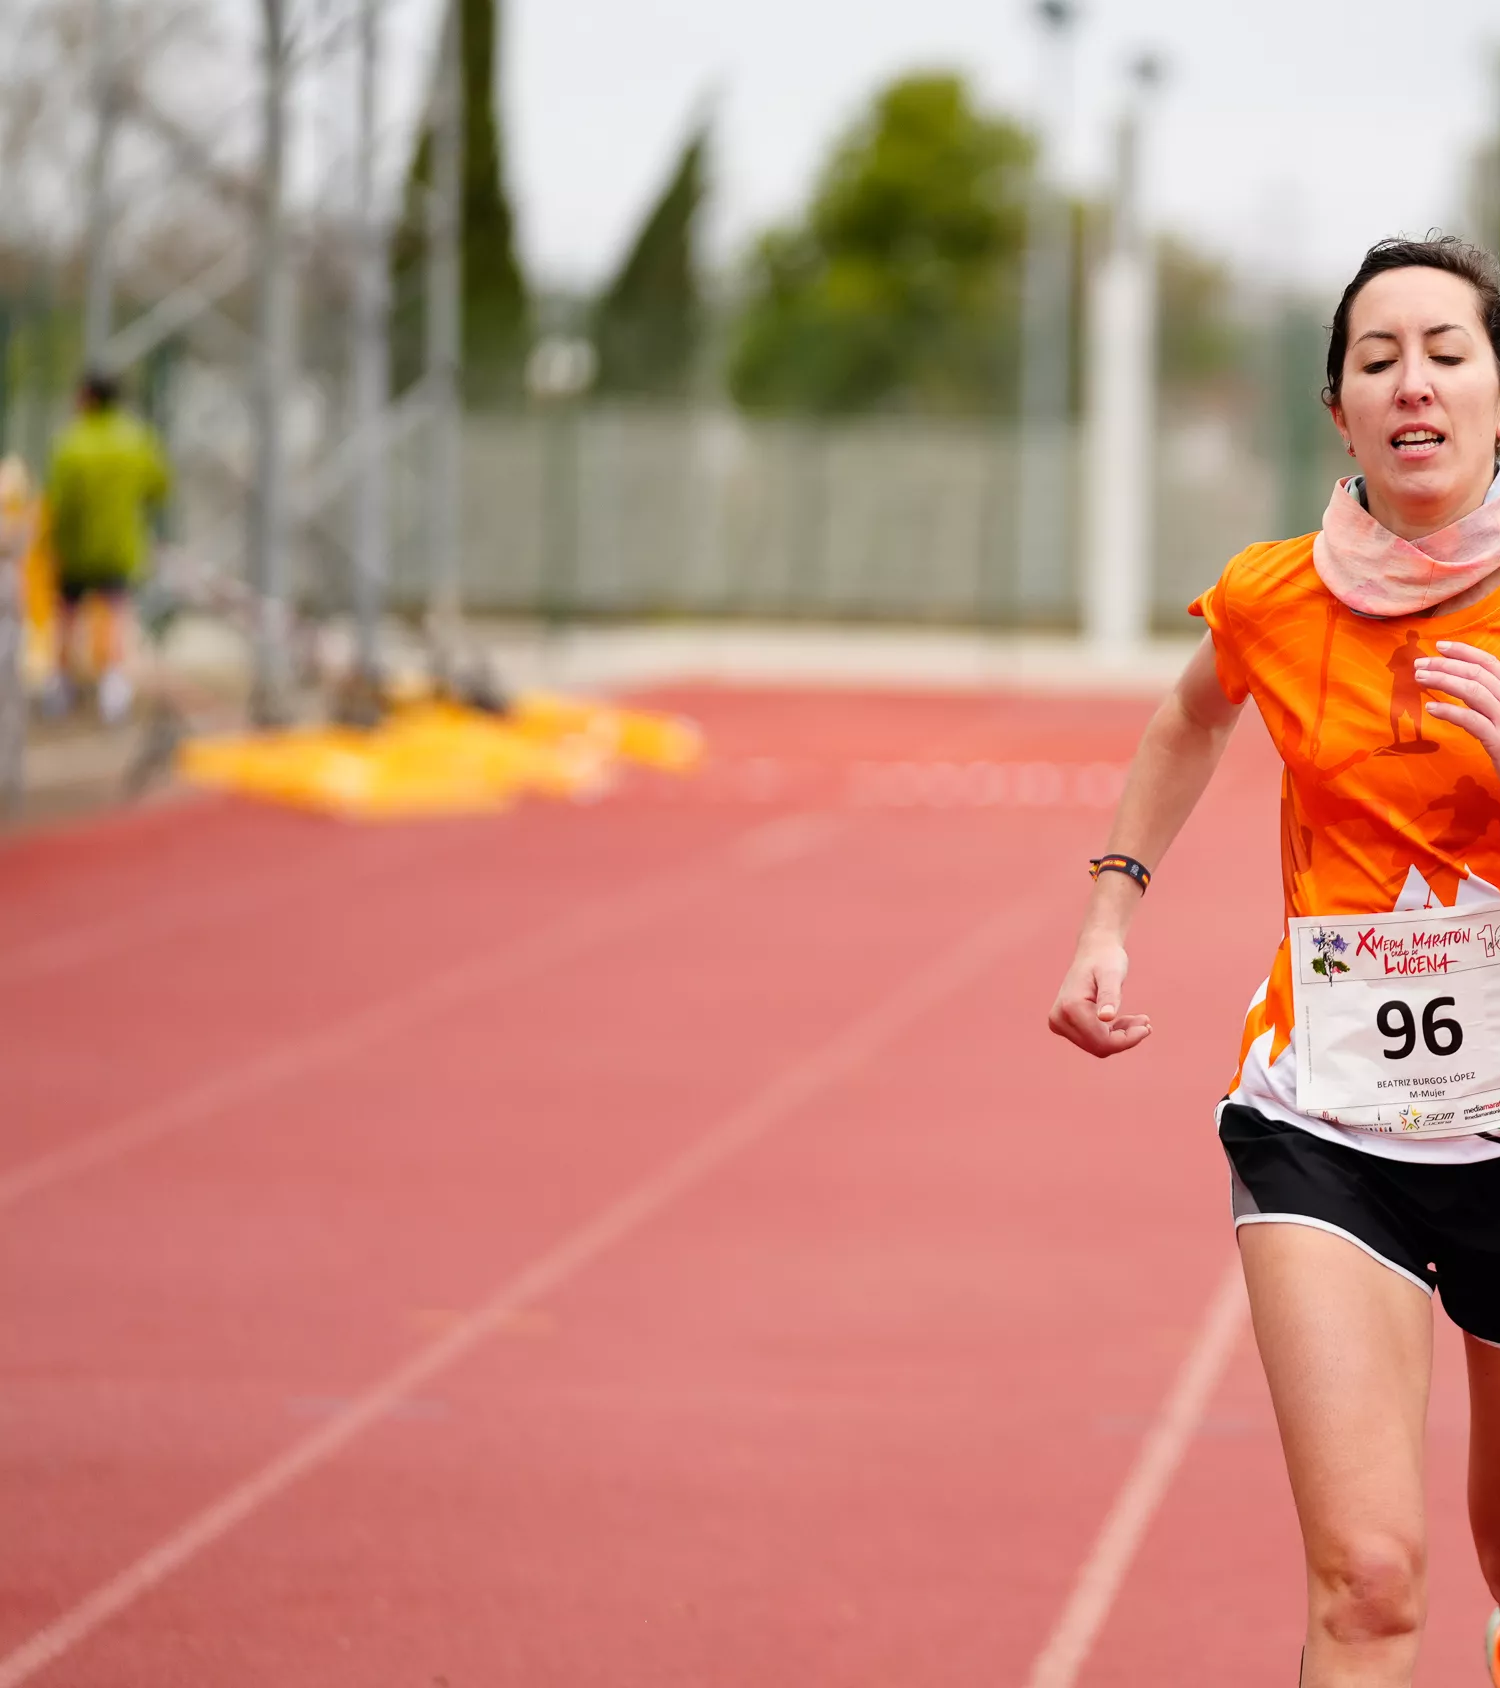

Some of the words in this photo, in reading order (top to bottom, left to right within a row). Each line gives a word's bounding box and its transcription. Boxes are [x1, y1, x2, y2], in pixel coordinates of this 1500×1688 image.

[1412, 927, 1471, 950] MARATÓN
[1384, 953, 1459, 976] LUCENA
[1377, 996, 1464, 1060] 96
[1377, 1078, 1411, 1089] BEATRIZ
[1412, 1076, 1448, 1086] BURGOS
[1449, 1071, 1476, 1083] LÓPEZ
[1409, 1089, 1446, 1098] M-Mujer
